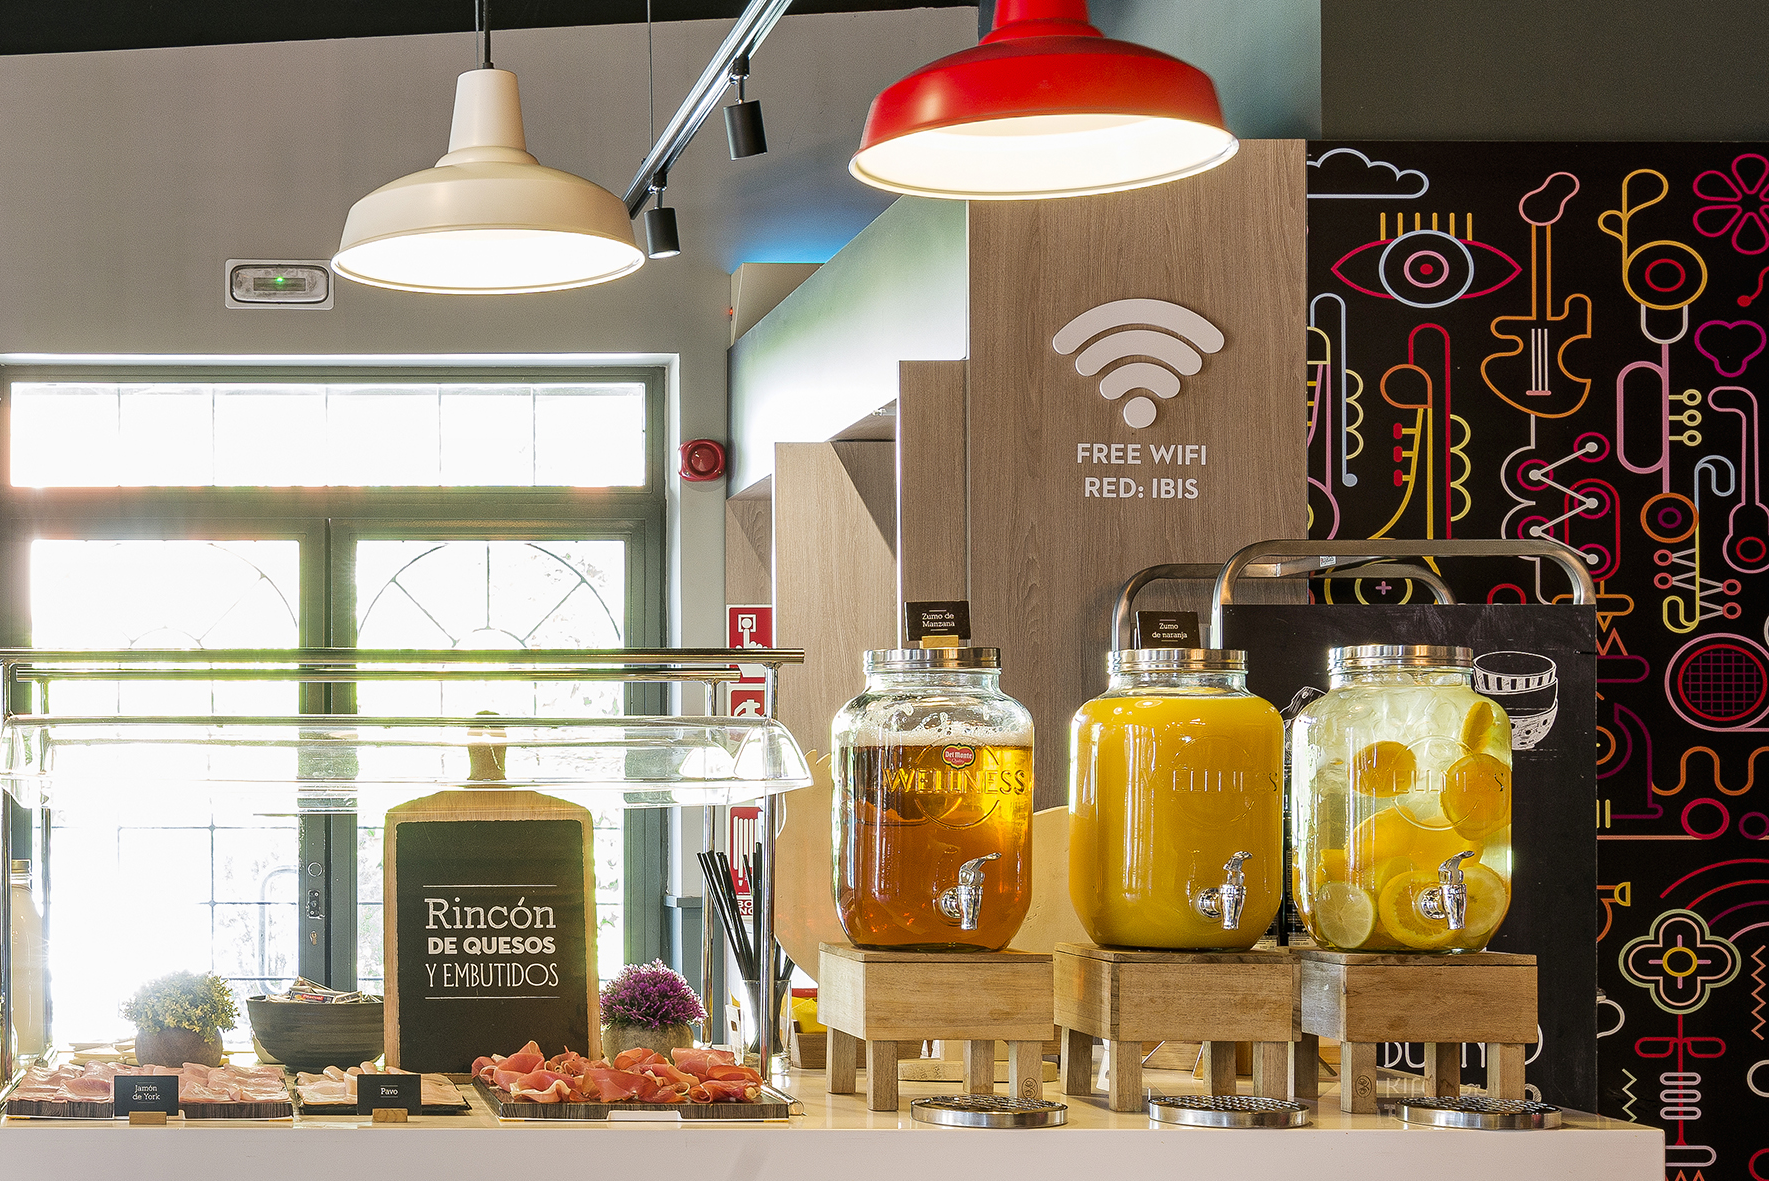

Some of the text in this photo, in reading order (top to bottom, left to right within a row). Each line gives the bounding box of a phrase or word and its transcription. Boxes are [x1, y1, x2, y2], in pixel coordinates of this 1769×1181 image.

[1077, 443, 1207, 466] FREE WIFI
[1084, 477, 1199, 500] RED: IBIS
[921, 612, 943, 620] Zumo
[922, 620, 955, 628] Manzana
[1159, 622, 1179, 630] Zumo
[1151, 631, 1188, 640] de naranja
[945, 750, 973, 760] Del Monte
[882, 768, 1026, 795] WELLNESS
[423, 896, 557, 930] Rincón
[427, 936, 557, 956] DE QUESOS
[425, 962, 560, 988] Y EMBUTIDOS
[134, 1084, 158, 1093] Jamón
[380, 1087, 399, 1096] Pavo
[132, 1092, 161, 1100] de York
